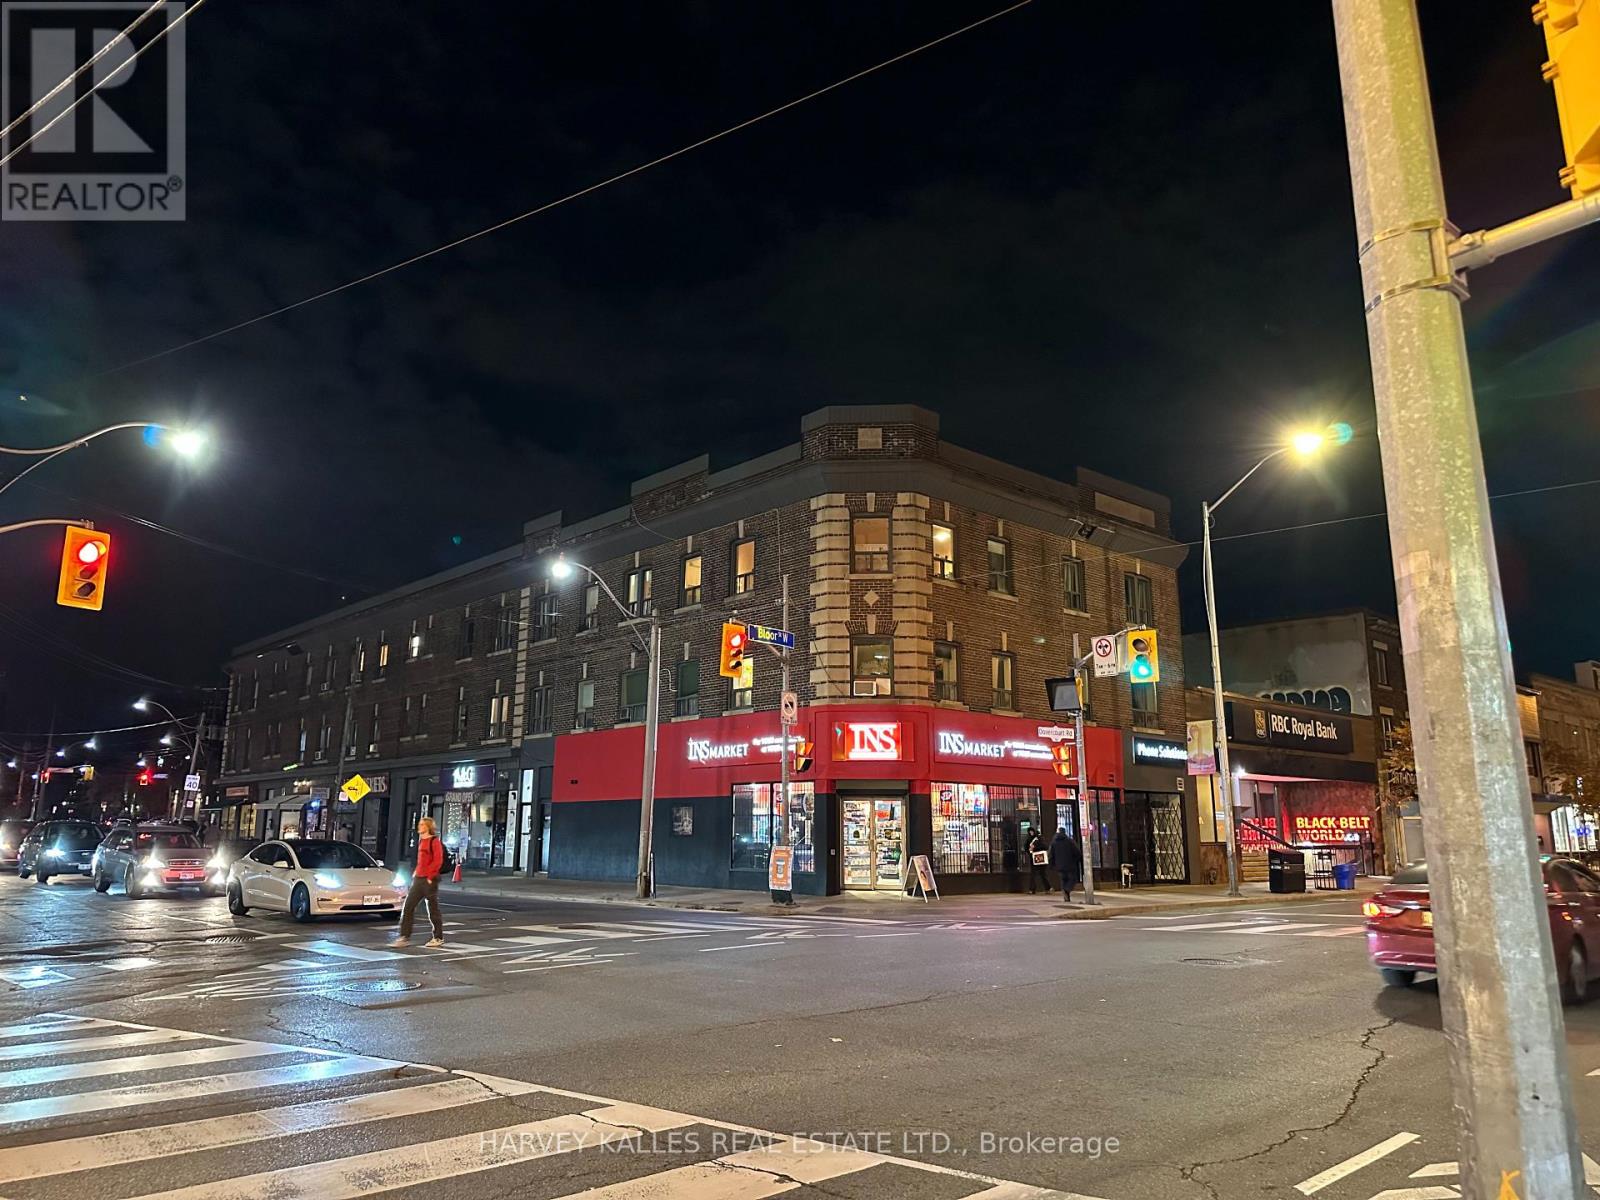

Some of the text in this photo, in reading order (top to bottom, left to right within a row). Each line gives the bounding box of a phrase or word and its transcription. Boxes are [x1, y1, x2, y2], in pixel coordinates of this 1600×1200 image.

[758, 627, 777, 641] Bloor
[783, 632, 788, 643] W
[849, 723, 898, 752] INS
[1271, 714, 1337, 740] RBC Royal Bank
[688, 737, 749, 763] INS MARKET
[939, 732, 965, 755] INS
[964, 741, 1005, 758] MARKET
[1137, 742, 1159, 758] Phone
[186, 781, 198, 789] 40
